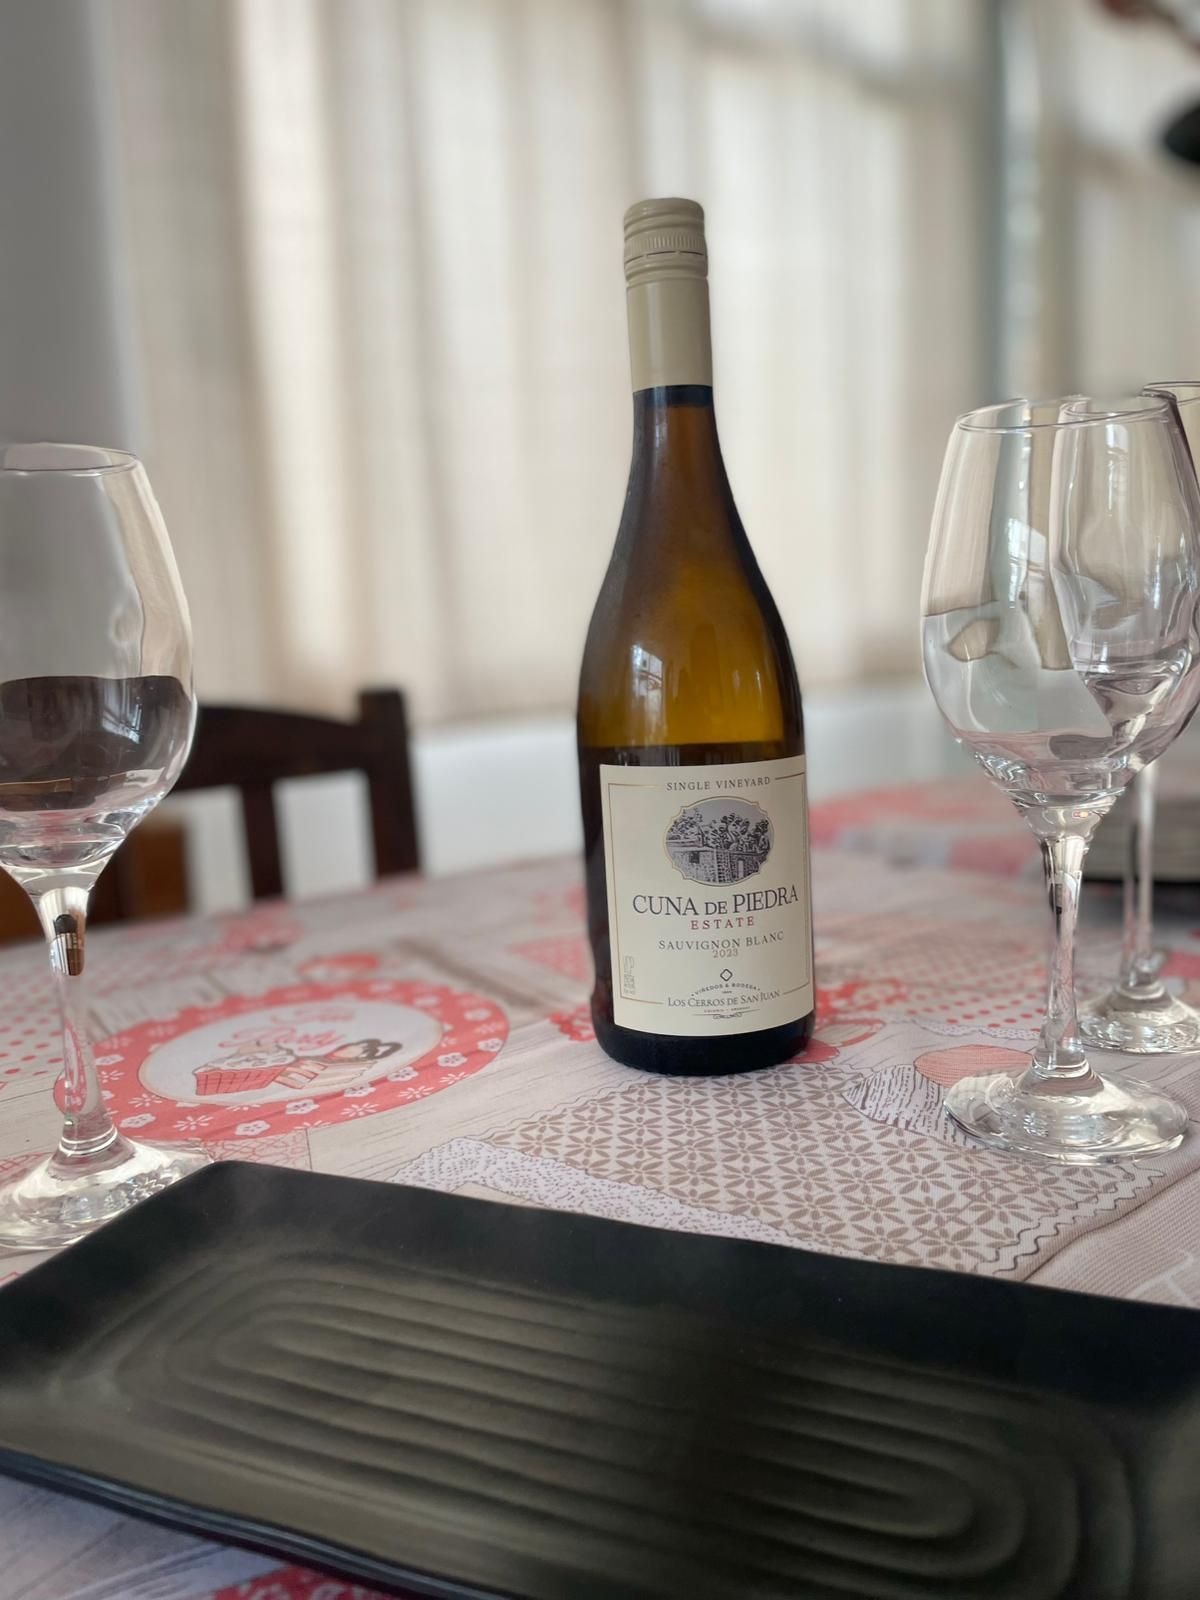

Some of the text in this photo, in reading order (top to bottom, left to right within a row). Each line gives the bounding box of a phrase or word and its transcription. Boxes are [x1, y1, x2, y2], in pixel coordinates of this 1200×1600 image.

[667, 776, 771, 791] SINGLE VINEYARD
[633, 885, 799, 916] CUNA DE PIEDRA
[691, 916, 755, 930] ESTATE
[658, 931, 785, 951] SAUVIGNON BLANC
[713, 949, 739, 959] 2023
